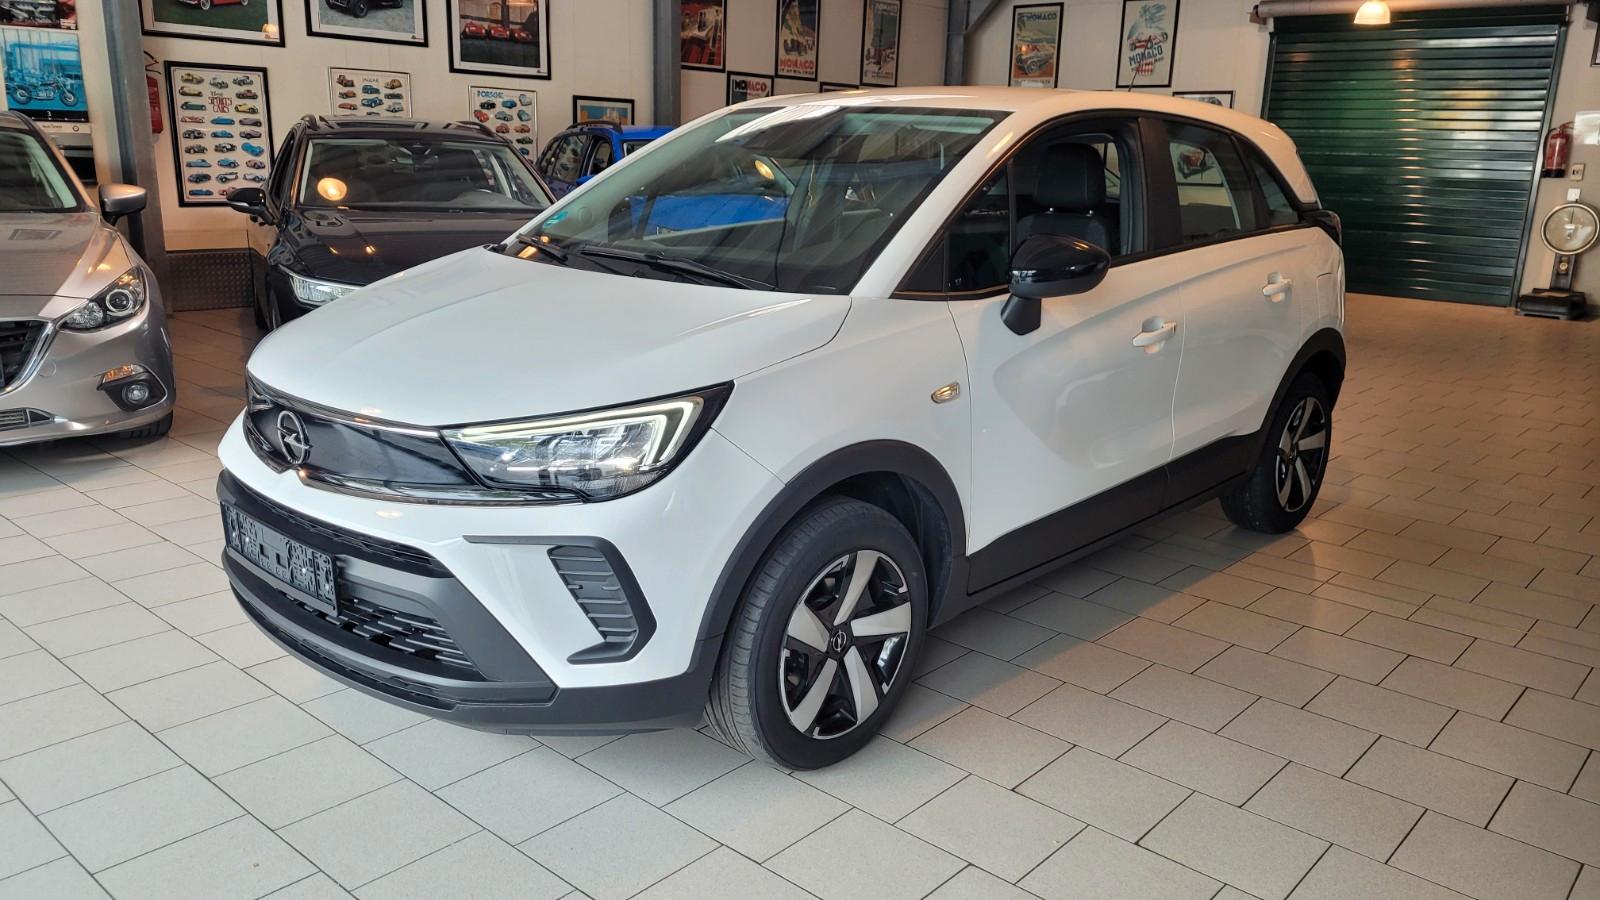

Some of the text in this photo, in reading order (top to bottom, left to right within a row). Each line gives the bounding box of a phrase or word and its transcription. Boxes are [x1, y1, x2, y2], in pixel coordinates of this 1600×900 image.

[1129, 45, 1163, 66] MONACO
[780, 57, 814, 70] MONACO
[734, 79, 767, 92] MONACO
